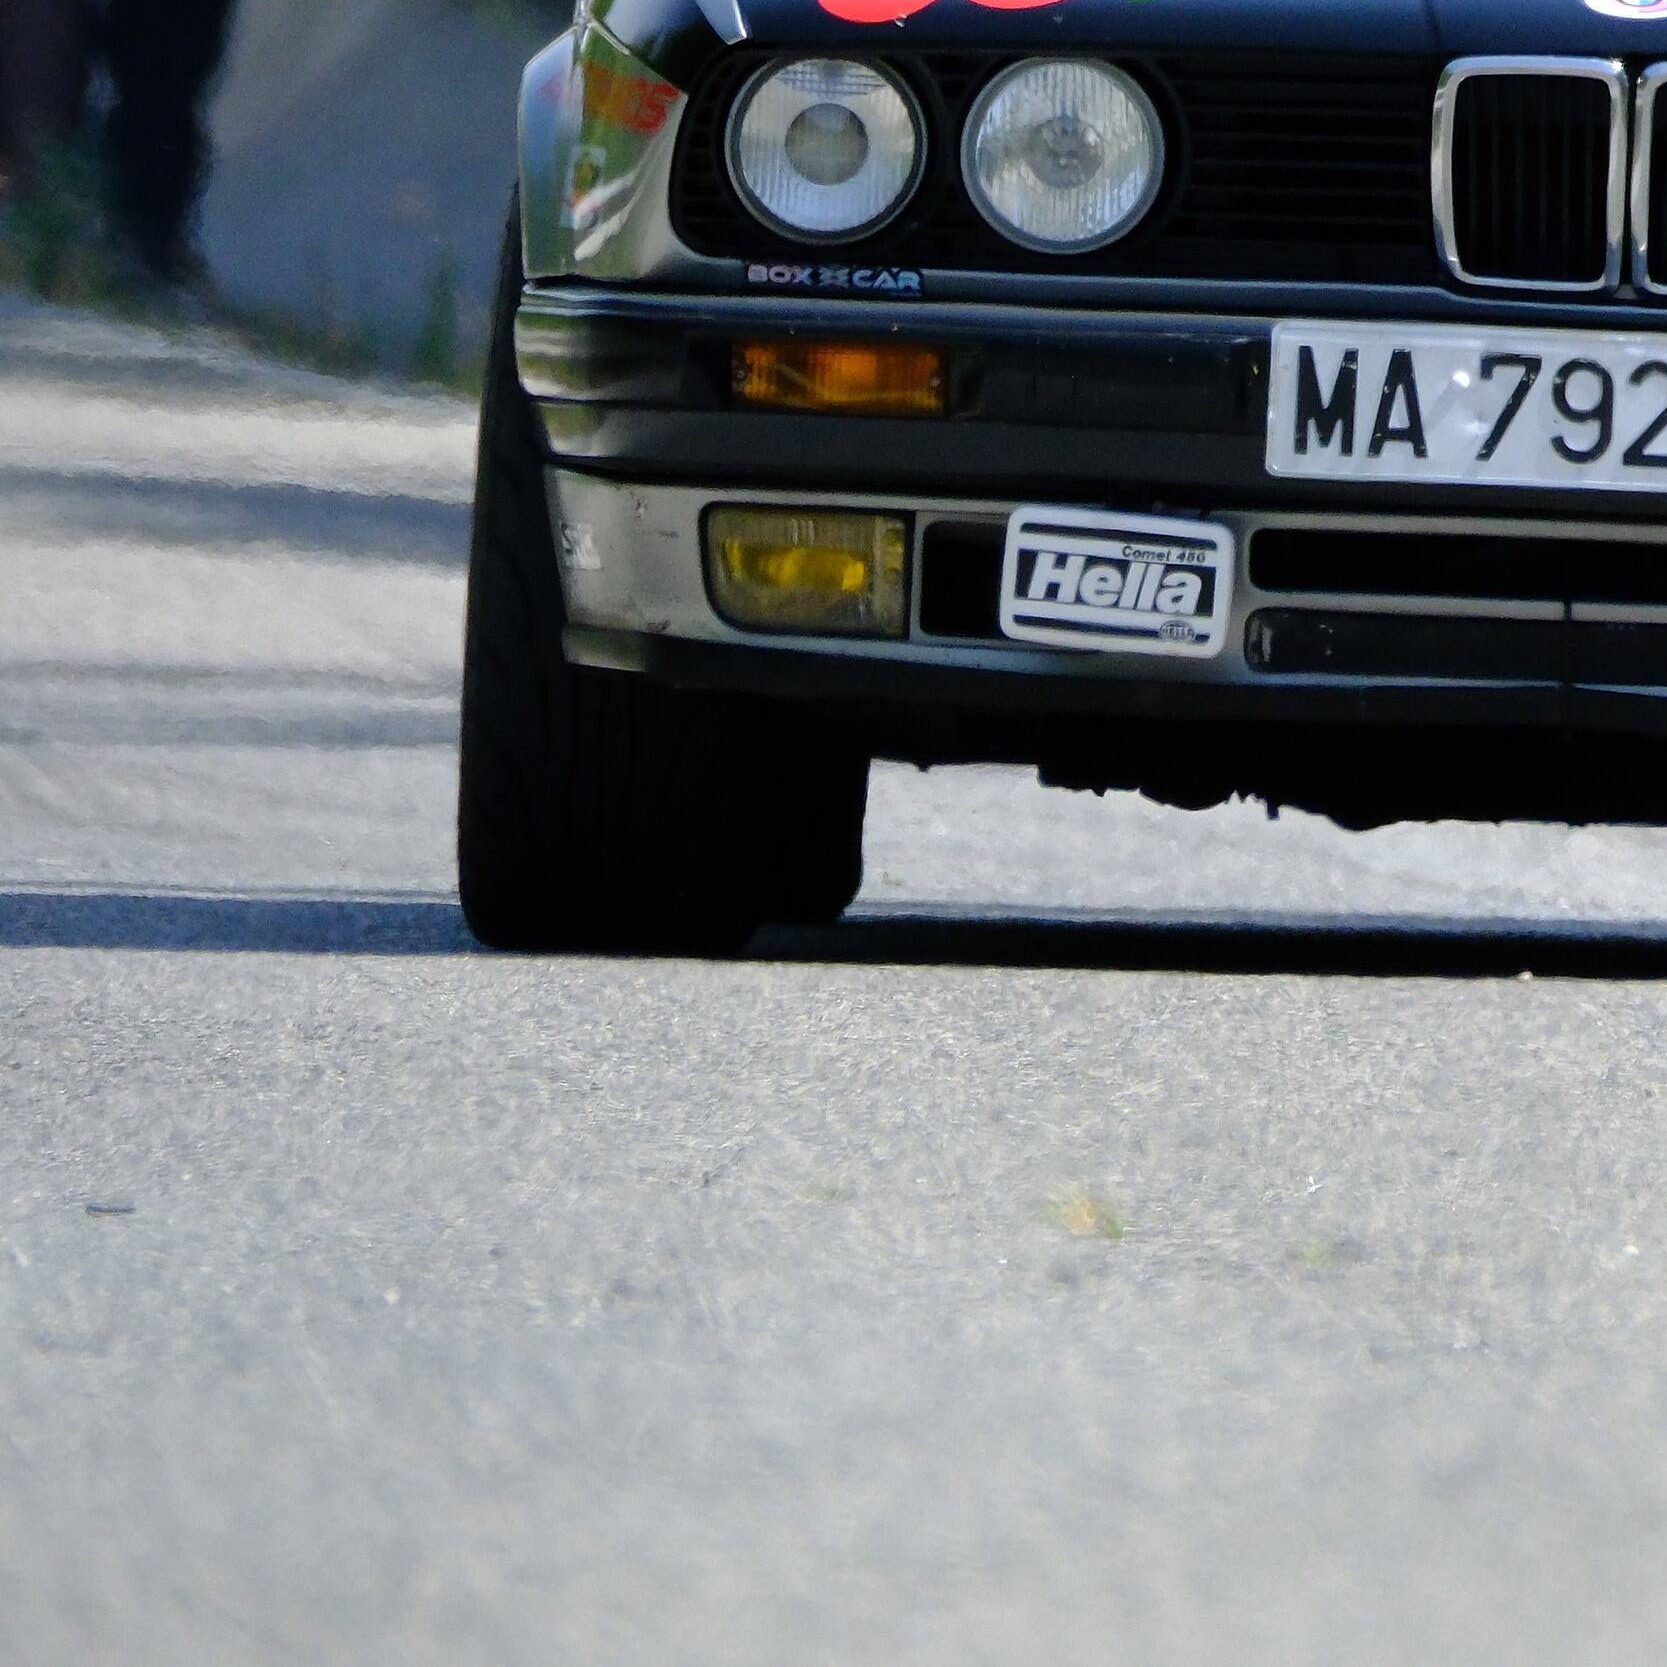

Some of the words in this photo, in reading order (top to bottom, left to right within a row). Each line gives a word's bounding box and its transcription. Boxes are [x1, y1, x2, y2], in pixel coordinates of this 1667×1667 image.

[851, 268, 921, 291] CAR
[1293, 345, 1428, 459] MA
[1121, 544, 1172, 563] Comet
[1026, 550, 1203, 616] Hella
